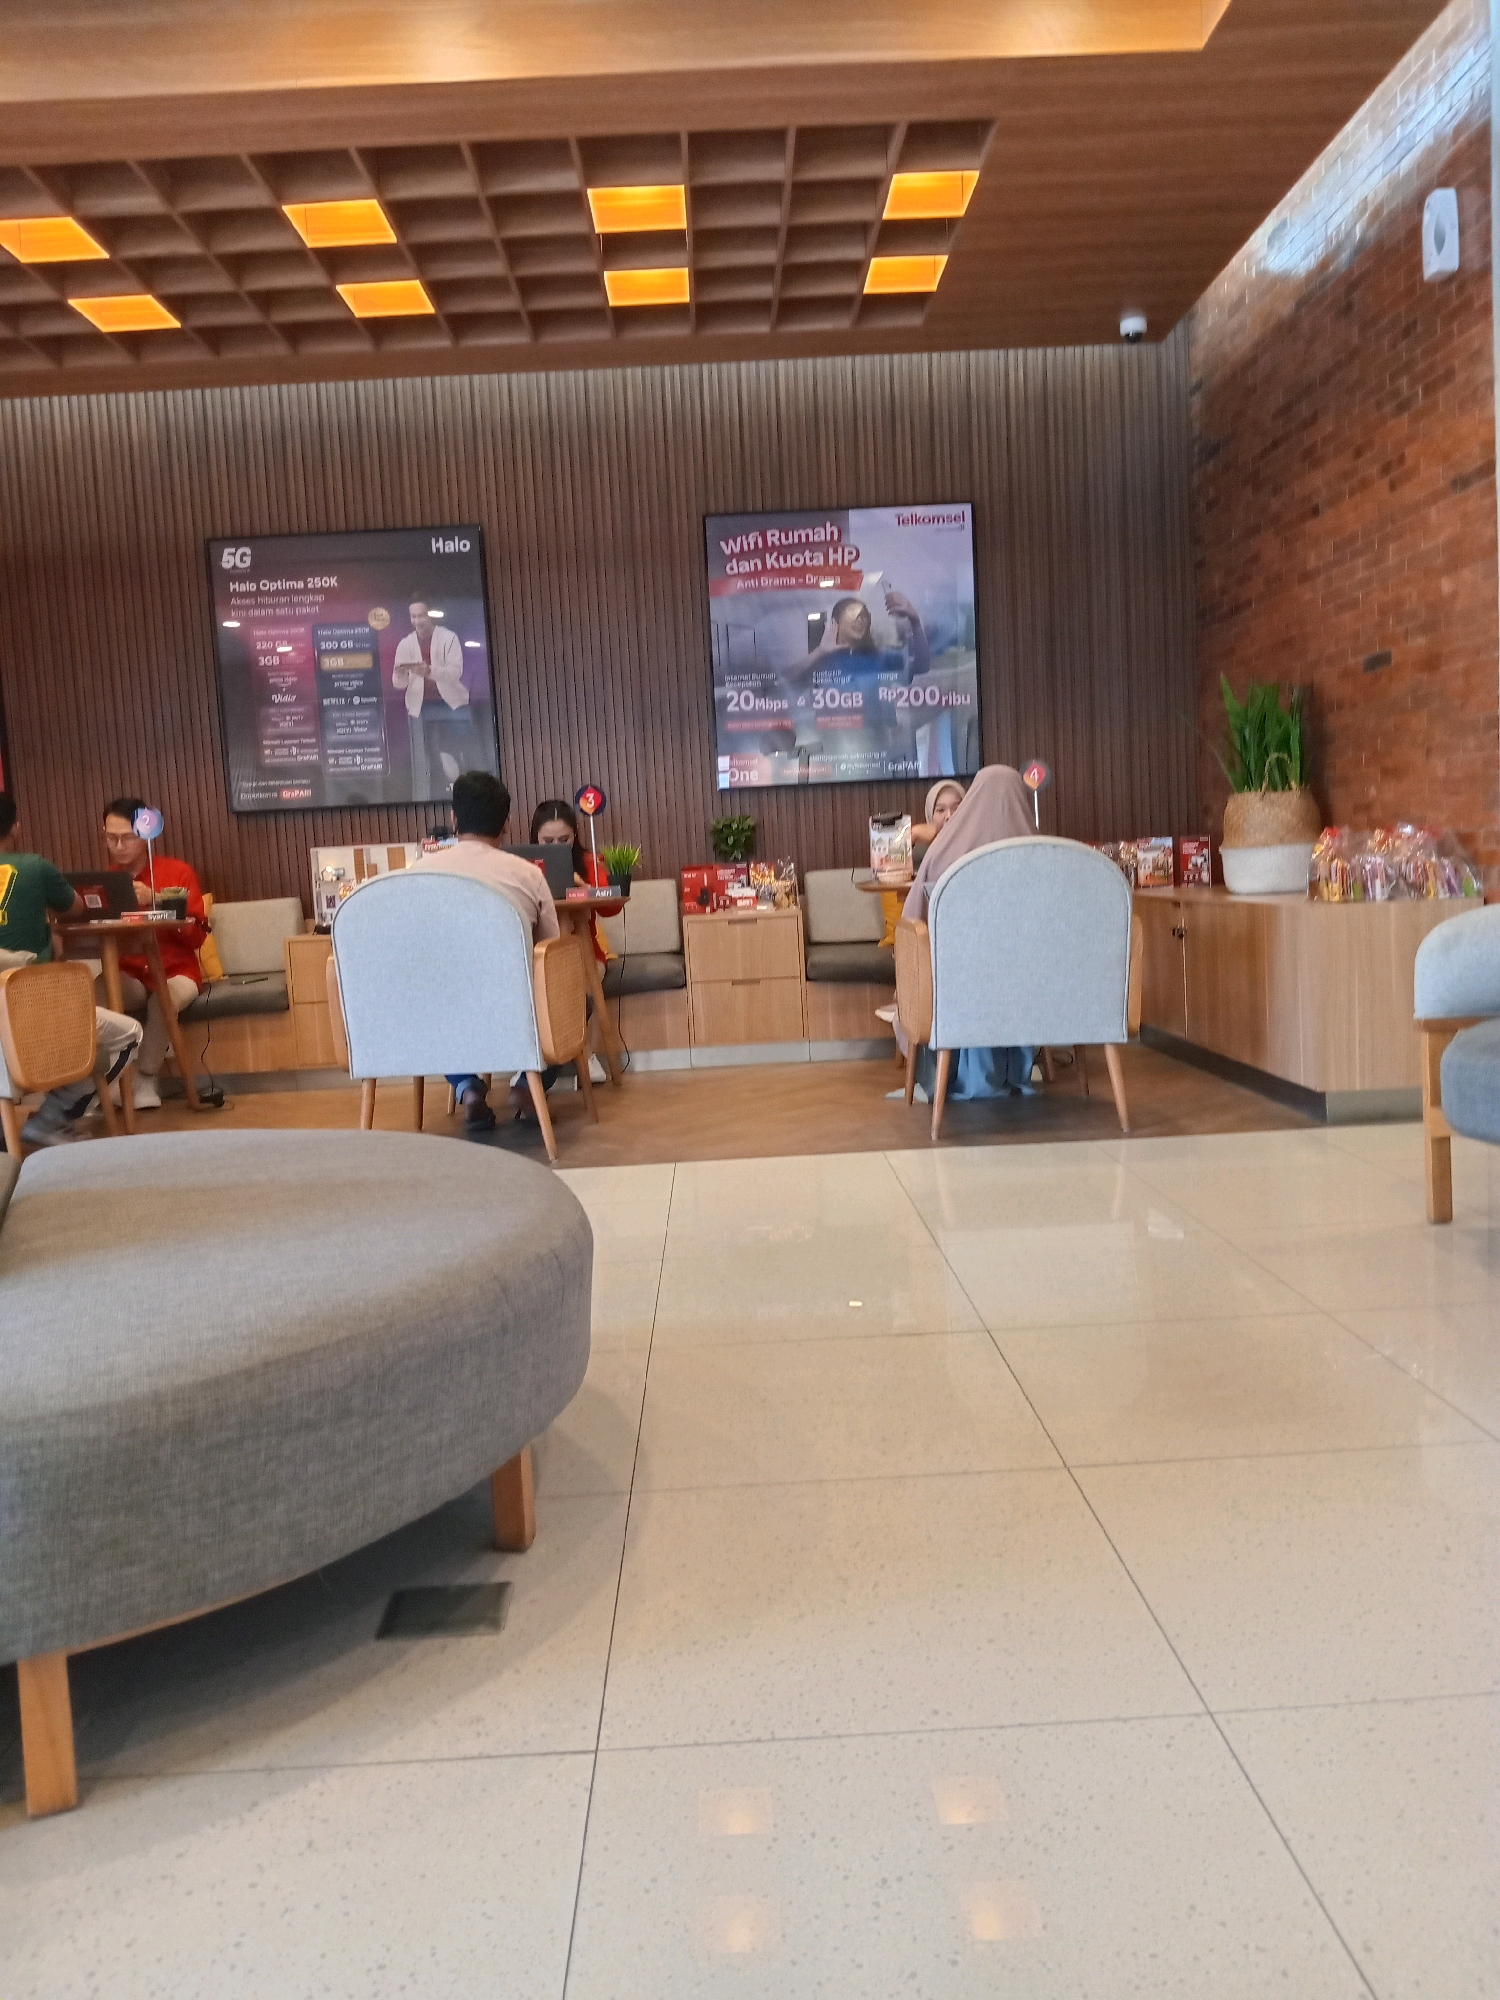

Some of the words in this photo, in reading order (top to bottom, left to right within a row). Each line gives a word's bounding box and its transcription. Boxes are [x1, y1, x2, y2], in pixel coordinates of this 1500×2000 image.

[895, 510, 965, 526] Telkomsel
[431, 536, 471, 554] Halo
[720, 531, 763, 555] Wifi
[766, 521, 839, 547] Rumah
[221, 547, 252, 569] 5G
[725, 558, 762, 575] dan
[765, 549, 824, 570] Kuota
[828, 546, 857, 566] HP
[229, 581, 257, 592] Halo
[260, 579, 305, 592] Optima
[307, 576, 338, 589] 250K
[736, 577, 759, 589] Anti
[760, 576, 796, 586] Drama
[248, 606, 274, 617] dalam
[275, 606, 294, 616] satu
[295, 605, 319, 616] paket
[340, 640, 354, 650] GB
[258, 655, 280, 667] 3GB
[812, 688, 863, 709] 30GB
[729, 768, 759, 782] One
[585, 792, 595, 809] 3
[142, 814, 152, 829] 2
